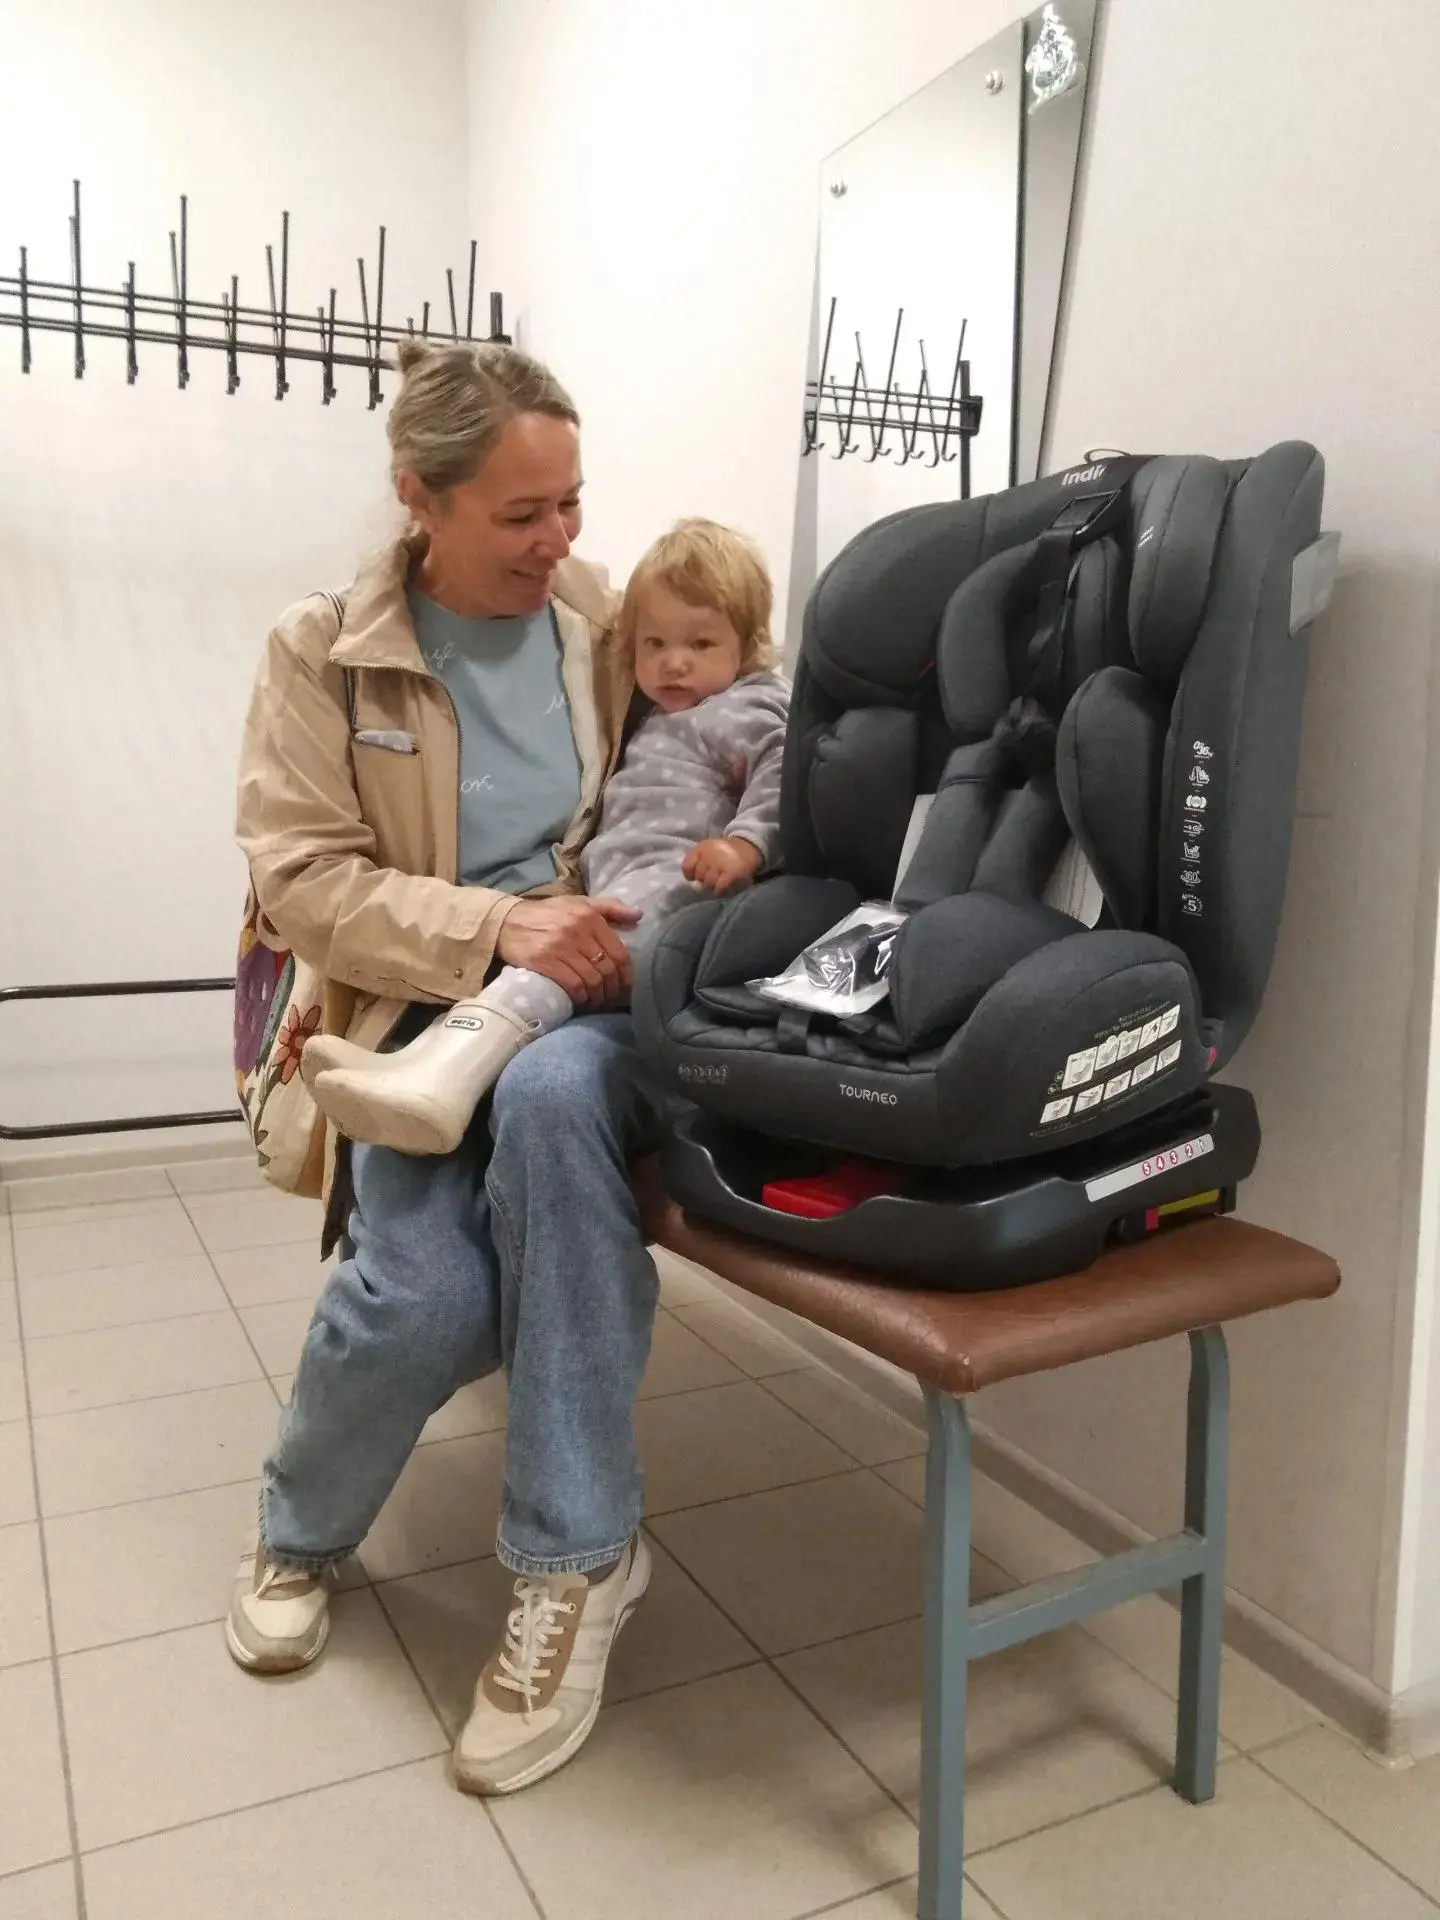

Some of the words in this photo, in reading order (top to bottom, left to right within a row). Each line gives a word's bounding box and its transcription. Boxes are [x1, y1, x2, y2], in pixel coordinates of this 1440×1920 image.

[839, 1083, 898, 1106] TOURNEO
[1143, 1162, 1151, 1176] 5
[1157, 1156, 1164, 1170] 4
[1170, 1151, 1177, 1164] 3
[1186, 1145, 1193, 1157] 2
